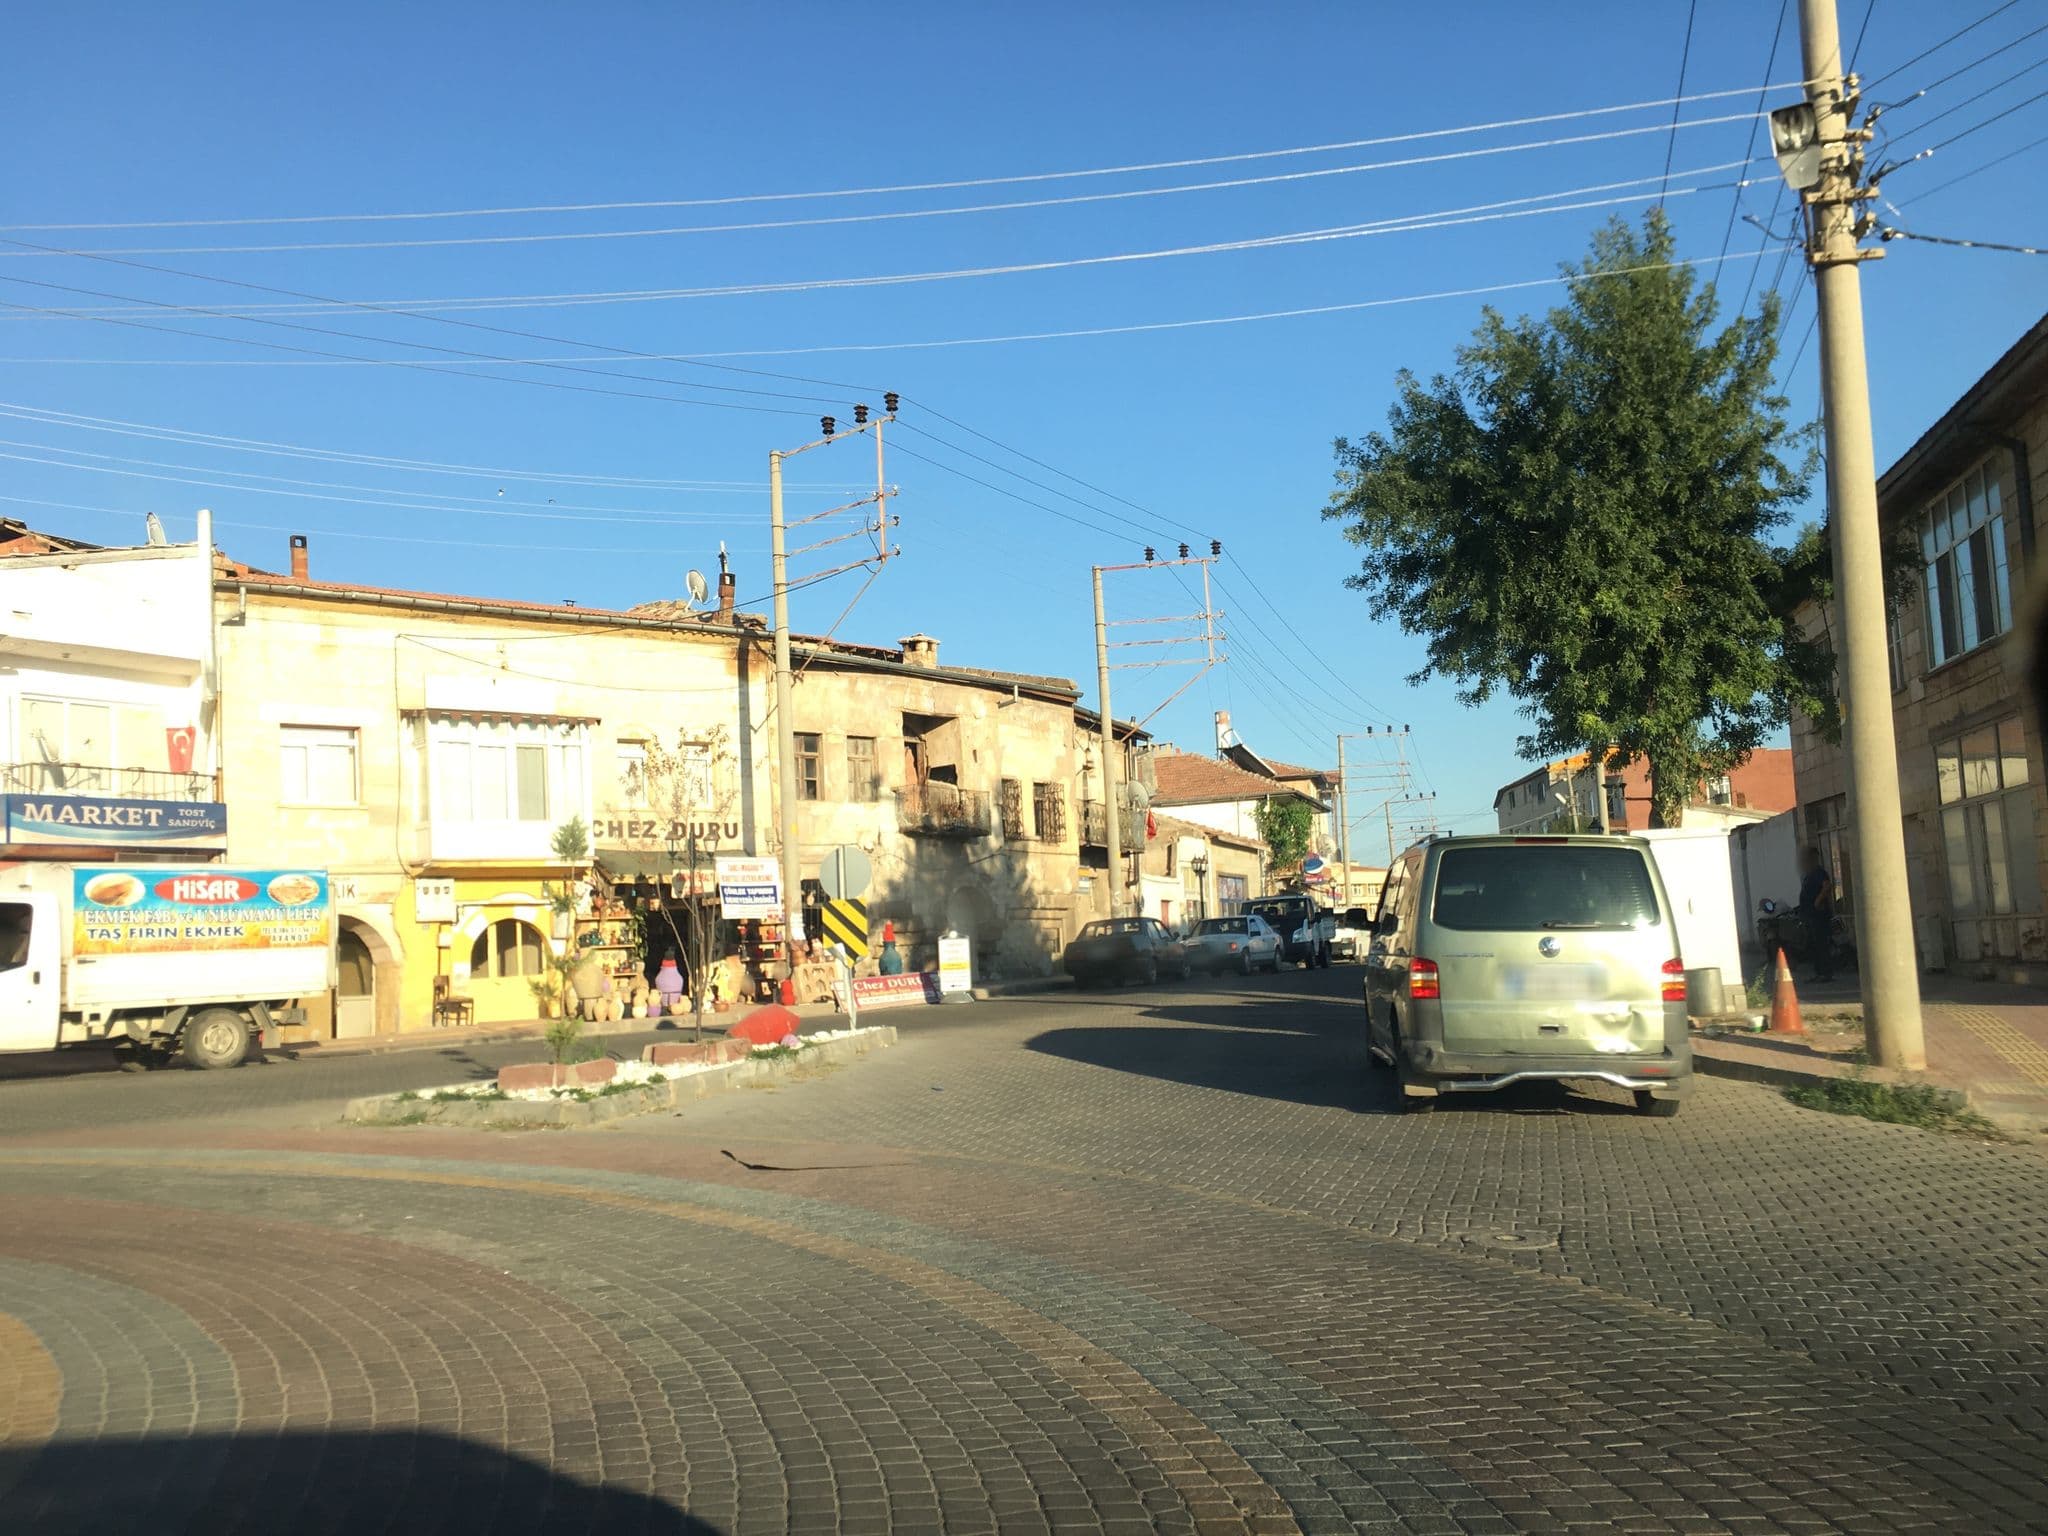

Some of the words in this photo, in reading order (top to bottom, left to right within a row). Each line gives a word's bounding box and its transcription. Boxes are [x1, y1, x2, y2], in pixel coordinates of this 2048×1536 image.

[22, 802, 163, 827] MARKET
[177, 808, 207, 817] TOST
[592, 820, 657, 839] CHEZ
[671, 821, 739, 840] DURU
[84, 909, 141, 925] EKMEK
[87, 927, 122, 940] TAŞ
[129, 927, 178, 939] FIRIN
[185, 926, 245, 938] EKMEK
[853, 980, 884, 991] Chez
